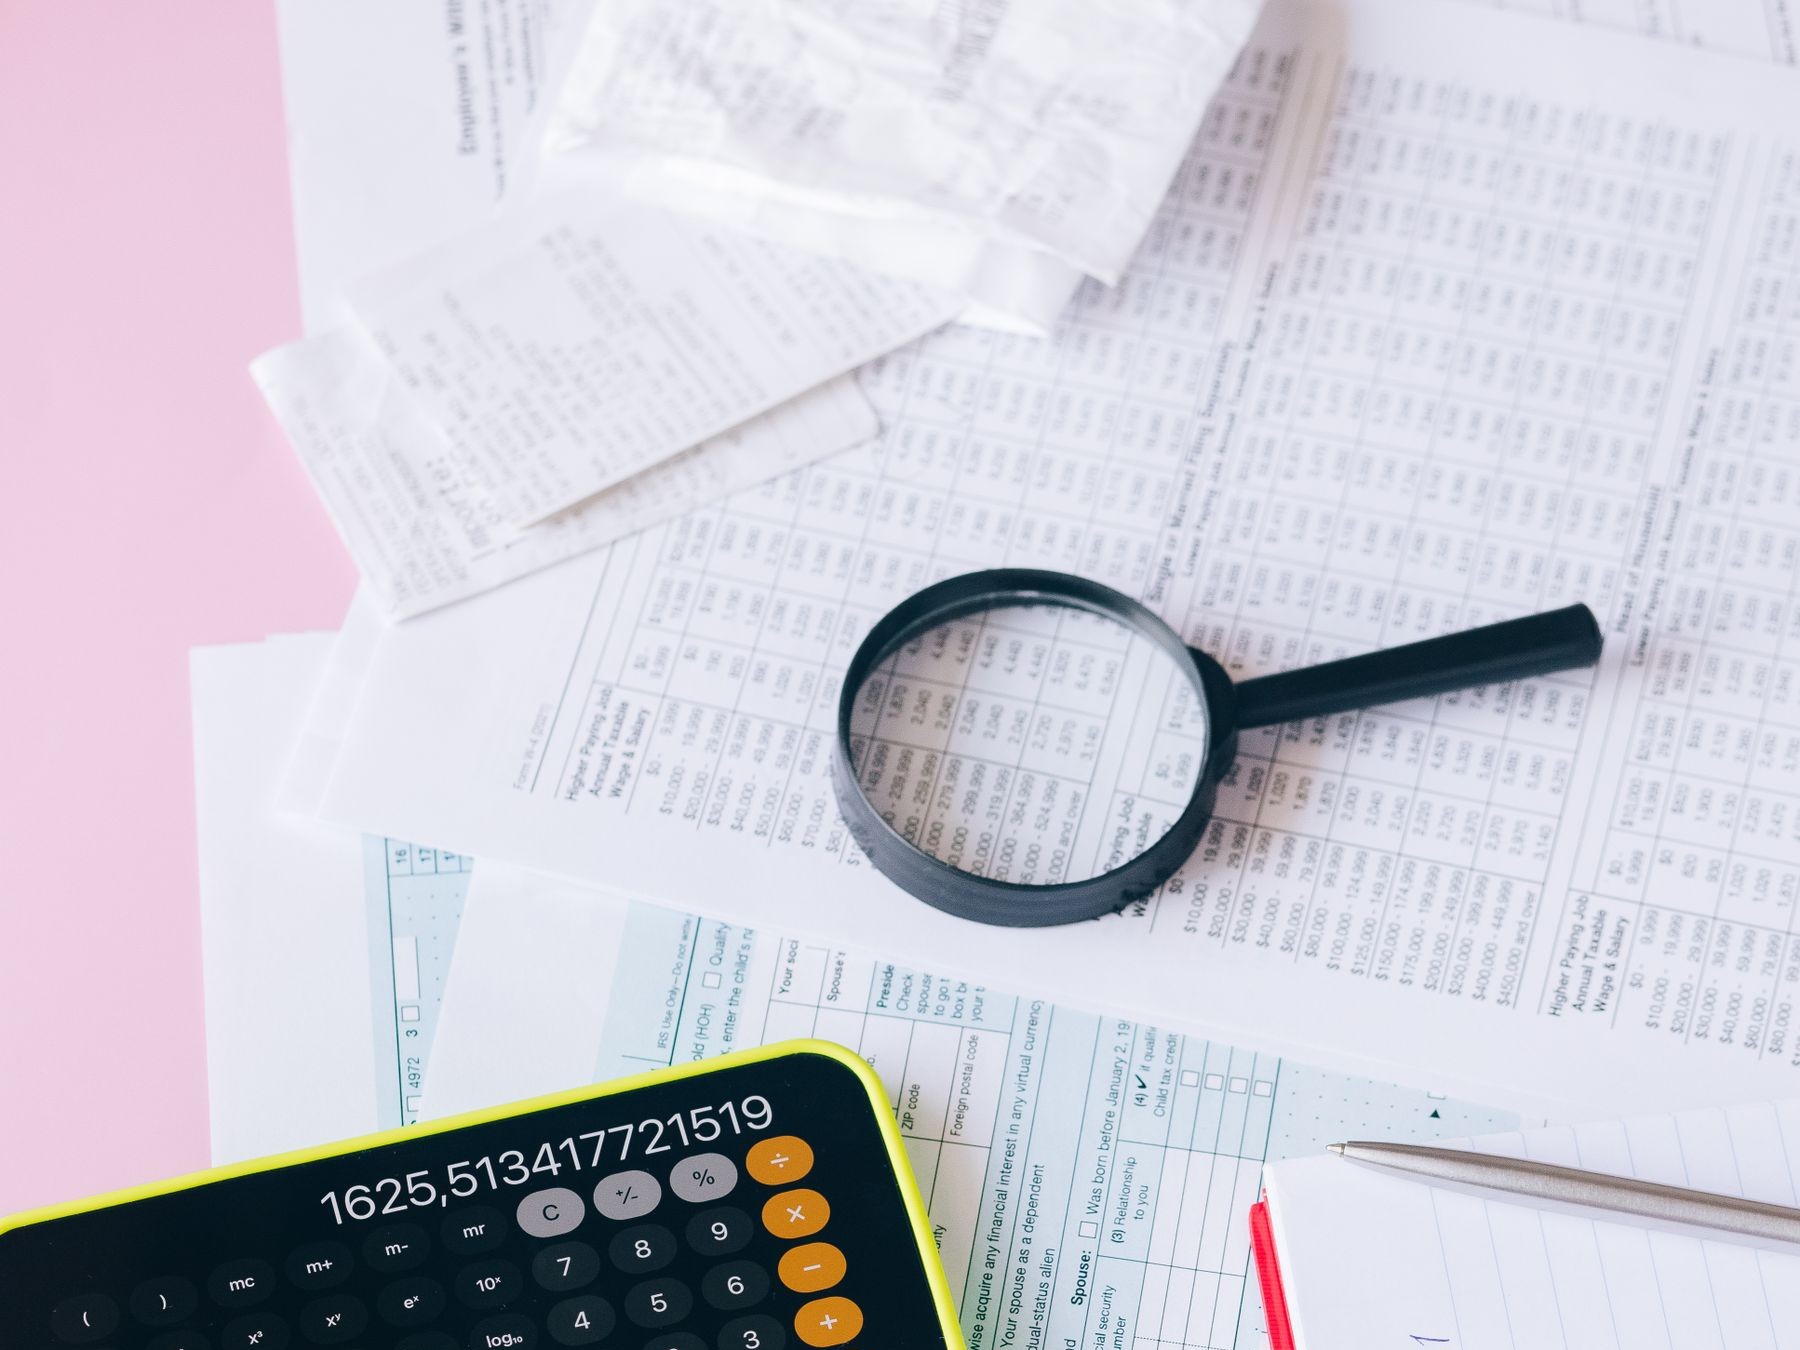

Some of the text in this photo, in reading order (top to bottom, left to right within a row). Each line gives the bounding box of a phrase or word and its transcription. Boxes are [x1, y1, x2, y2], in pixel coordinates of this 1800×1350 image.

[1547, 892, 1595, 1018] Higher Paying Job
[1571, 908, 1608, 1014] Annual Taxable
[1591, 915, 1631, 1013] Wage & Salary
[406, 1056, 422, 1090] 4972
[319, 1093, 776, 1228] 1625,513417721519
[692, 1168, 716, 1187] %
[1109, 1156, 1139, 1245] (3) Relationship
[1131, 1184, 1150, 1221] to you
[542, 1204, 560, 1222] C
[462, 1224, 486, 1239] mr
[711, 1222, 728, 1241] 9
[634, 1239, 652, 1259] 8
[998, 1164, 1046, 1349] Your spouse as a dependent
[306, 1259, 333, 1274] m+
[556, 1256, 571, 1277] 7
[229, 1277, 255, 1292] mc
[727, 1275, 745, 1295] 6
[1069, 1249, 1092, 1307] Spouse:
[650, 1292, 668, 1313] 5
[1098, 1284, 1118, 1331] security
[574, 1311, 591, 1329] 4
[743, 1330, 760, 1350] 3
